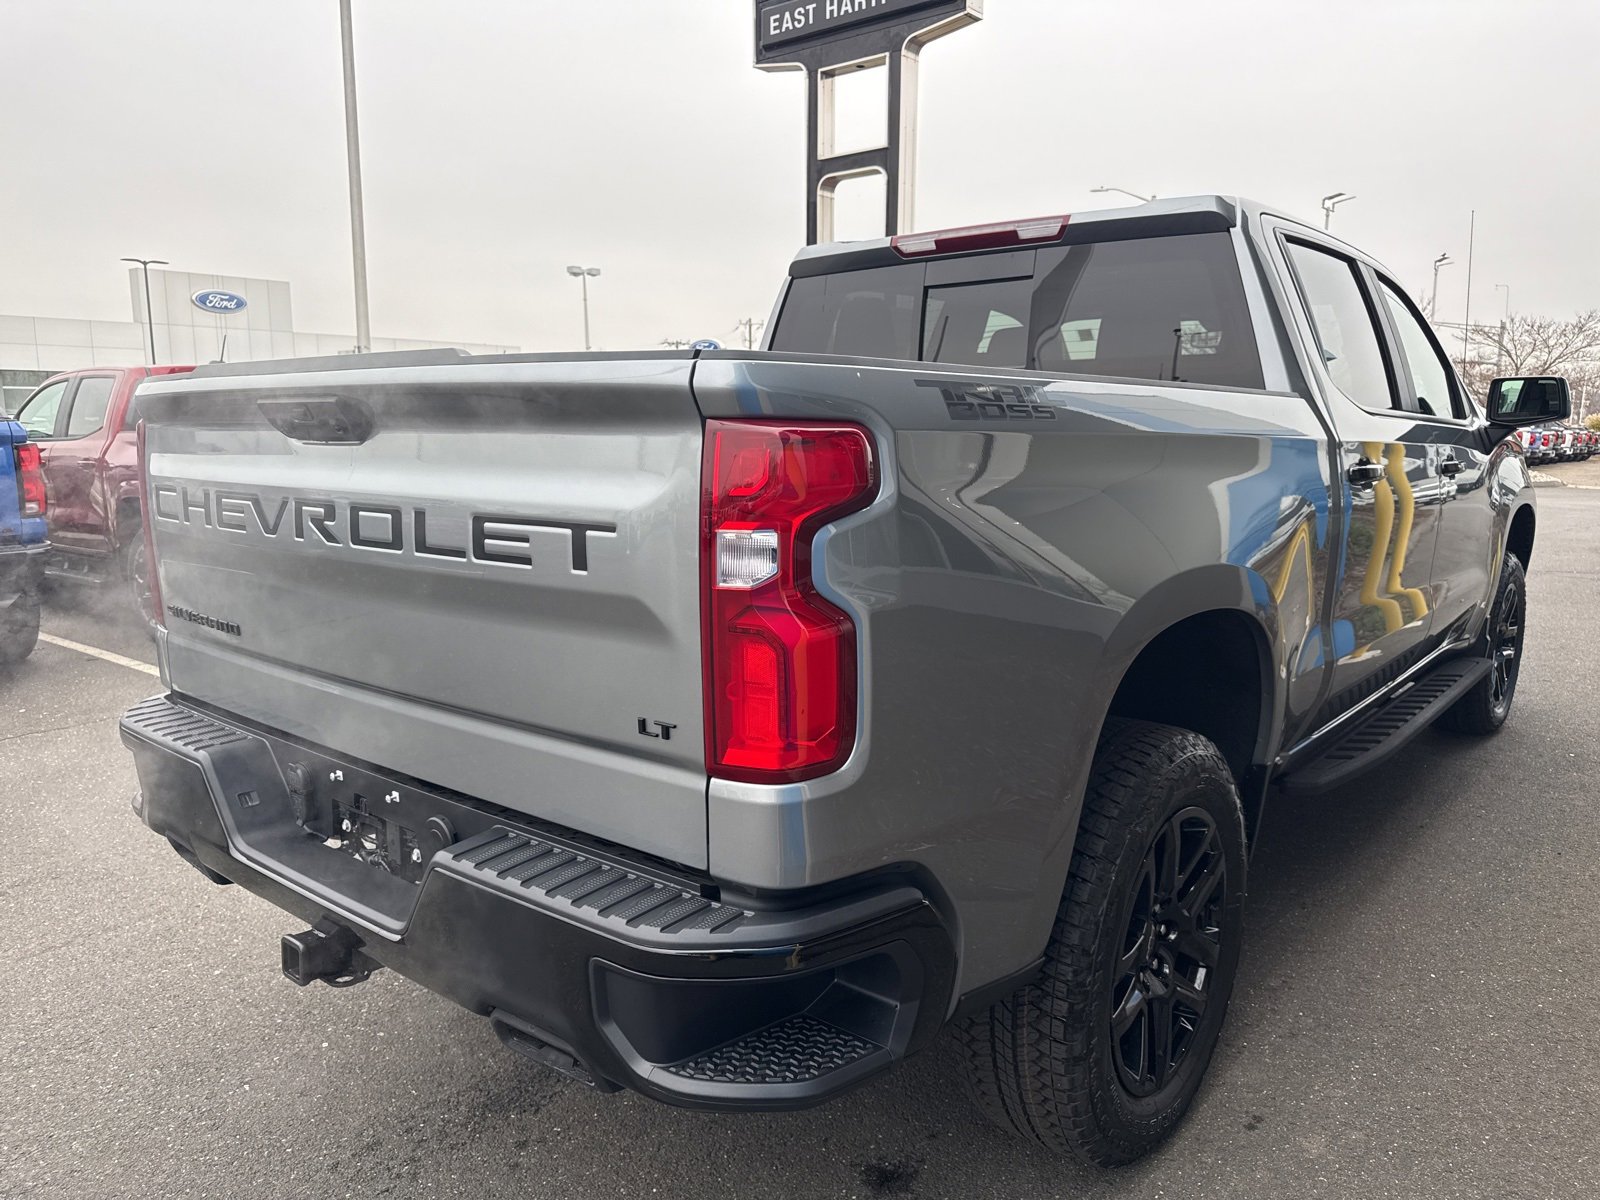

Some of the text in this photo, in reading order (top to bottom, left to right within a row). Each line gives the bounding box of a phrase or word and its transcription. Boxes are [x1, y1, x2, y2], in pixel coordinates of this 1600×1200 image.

[769, 0, 886, 35] EAST HAR
[206, 294, 237, 309] Ford
[914, 379, 1066, 404] TRAIL
[946, 402, 1056, 420] BOSS
[154, 485, 617, 575] CHEVROLET
[637, 716, 677, 740] LT
